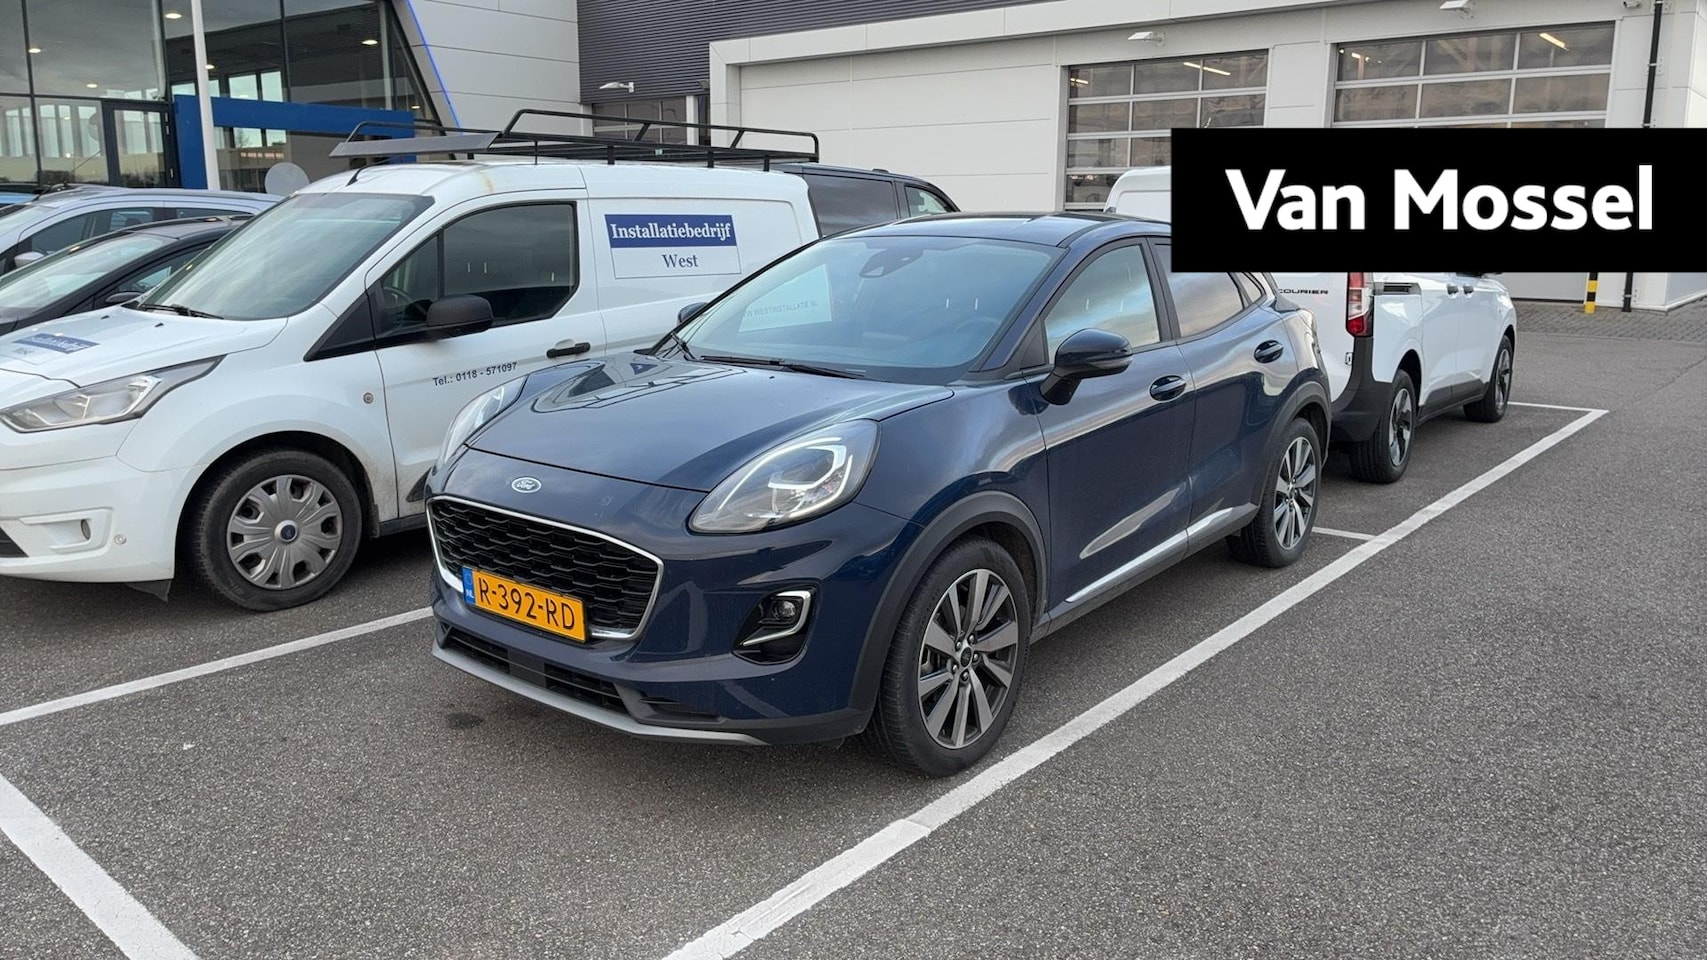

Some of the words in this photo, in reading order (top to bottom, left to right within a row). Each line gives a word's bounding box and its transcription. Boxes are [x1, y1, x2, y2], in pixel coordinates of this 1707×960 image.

[610, 223, 731, 241] Installatiebedrijf
[662, 254, 698, 268] West
[432, 376, 453, 386] Tel.:
[455, 370, 478, 381] 0118
[486, 362, 517, 375] 571097
[478, 577, 575, 630] R-392-RD
